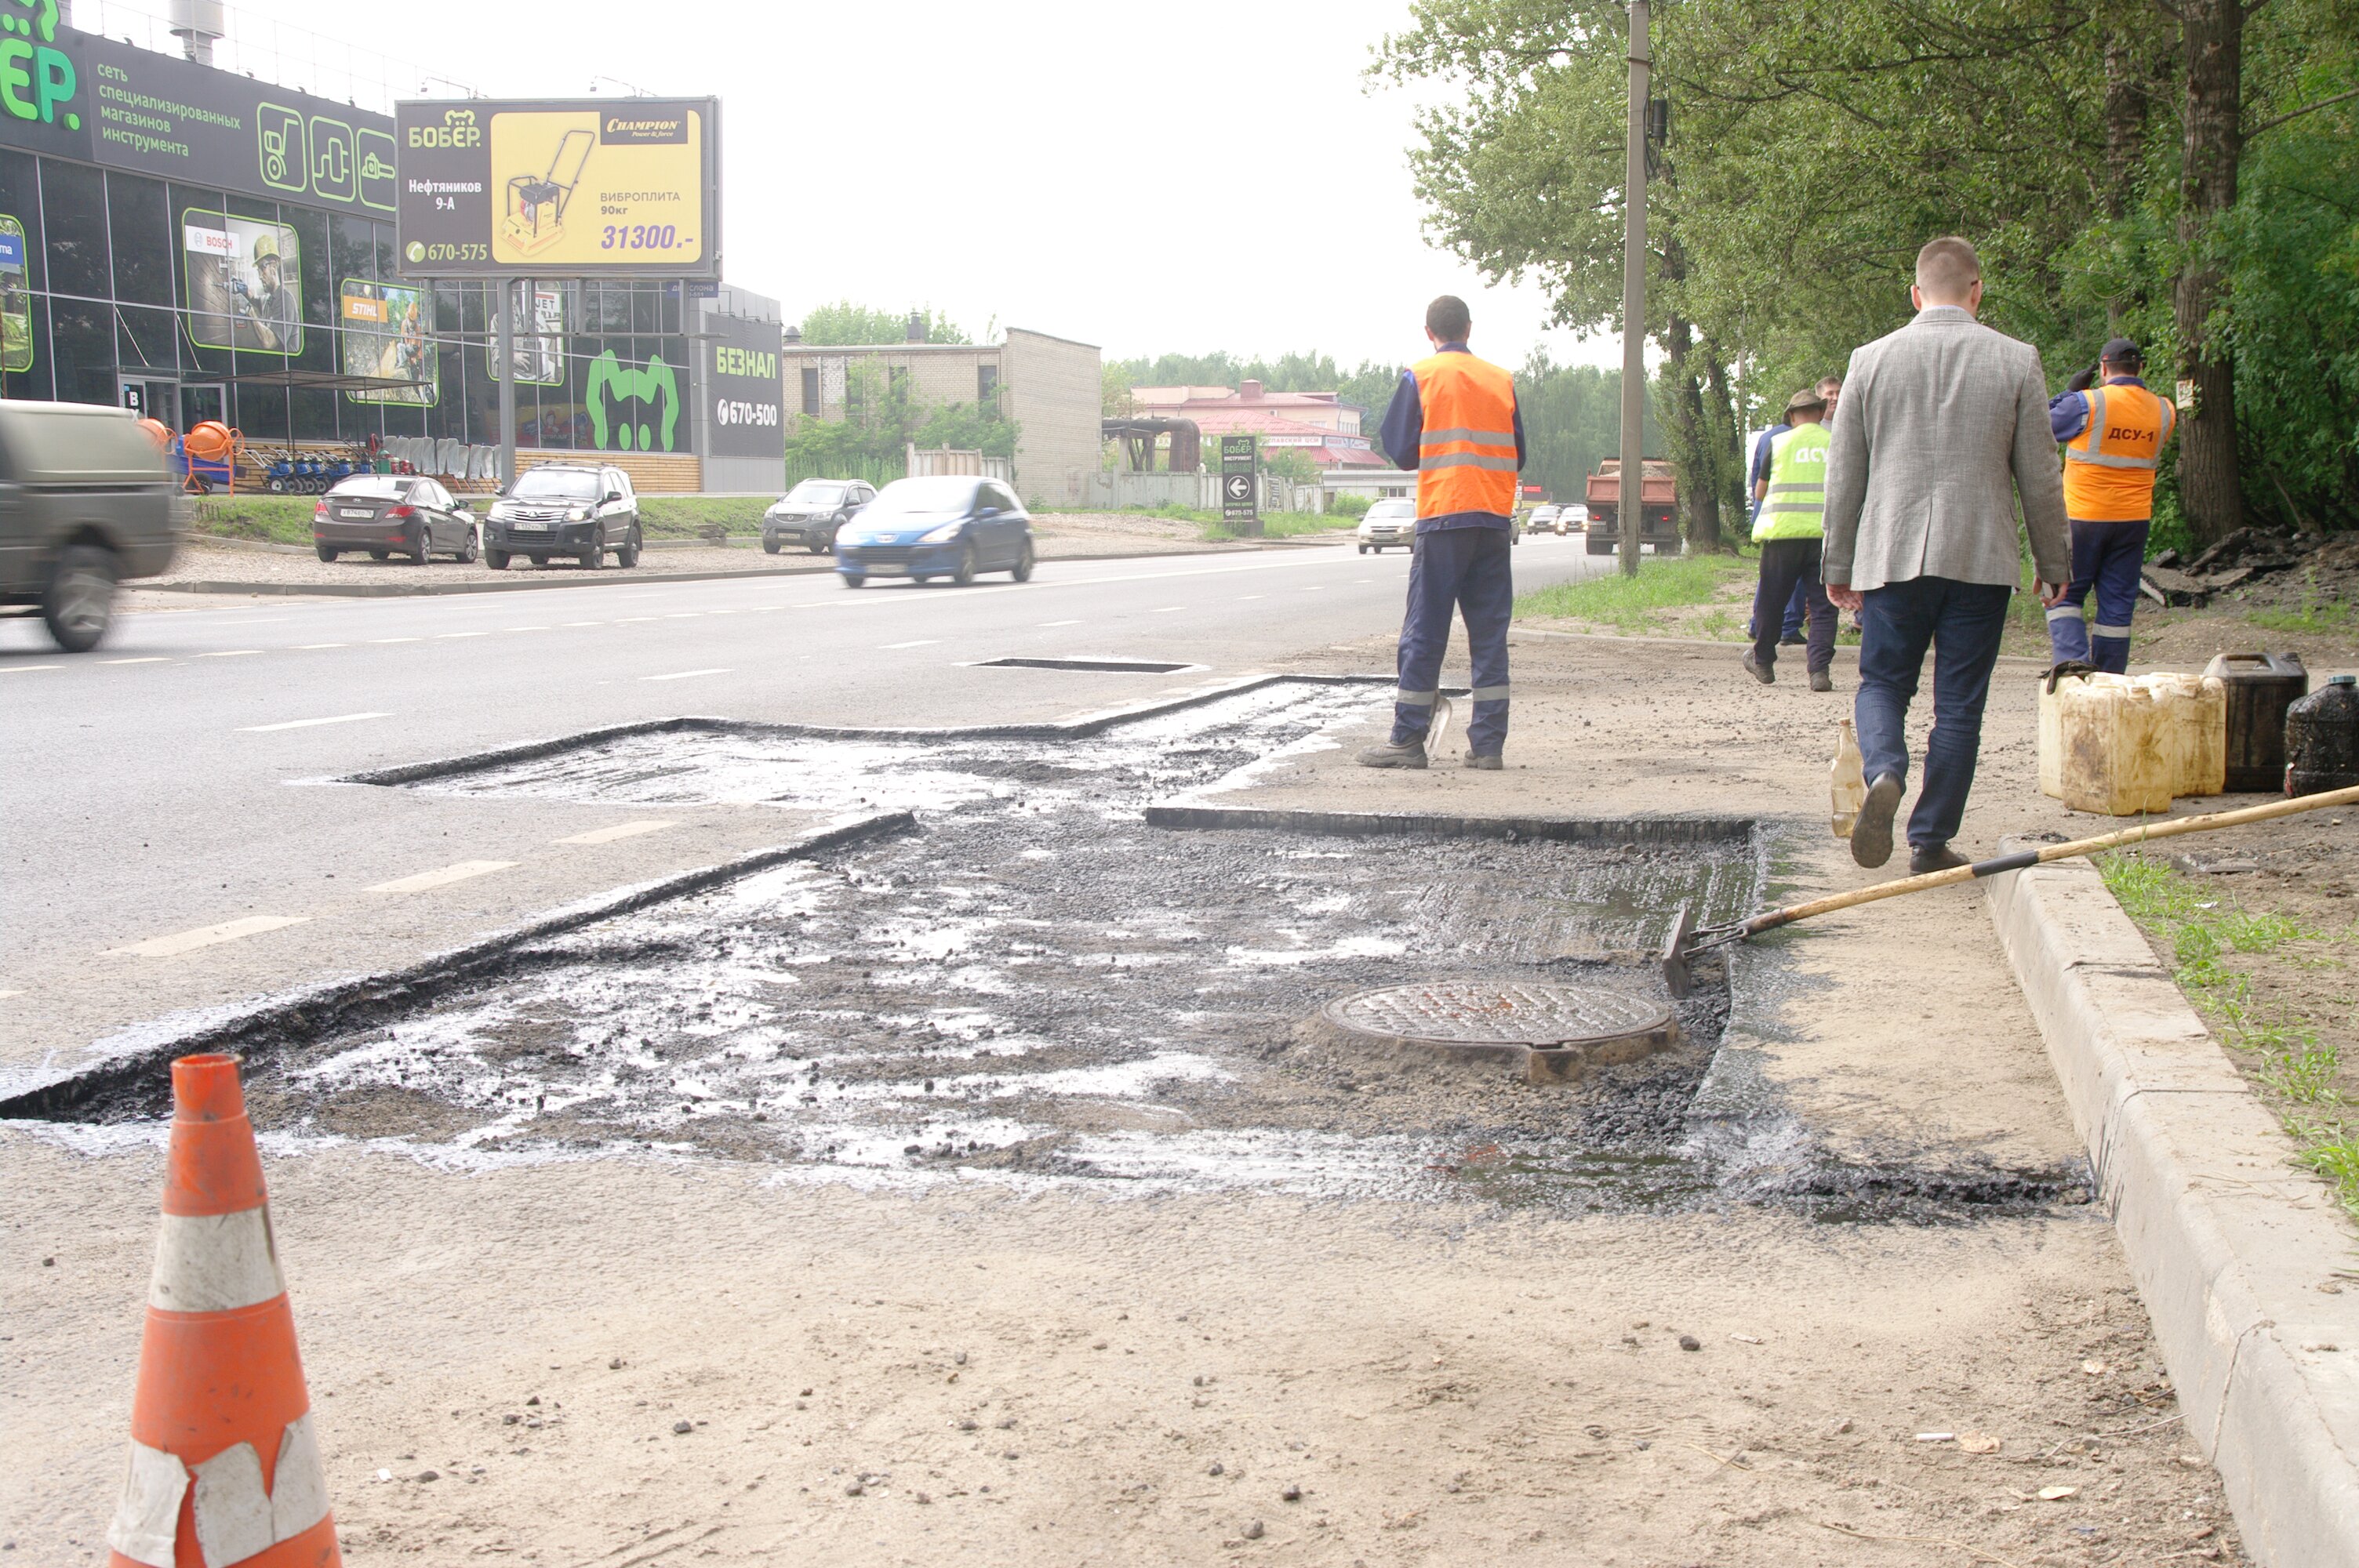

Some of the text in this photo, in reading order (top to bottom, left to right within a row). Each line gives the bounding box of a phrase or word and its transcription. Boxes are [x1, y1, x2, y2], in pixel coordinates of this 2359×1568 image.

[97, 63, 129, 82] сеть
[99, 85, 241, 130] специализированных
[100, 105, 171, 132] магазинов
[103, 126, 189, 157] инструмента
[409, 179, 482, 196] Нефтяников
[435, 197, 455, 210] 9-А
[601, 192, 681, 202] ВИБРОПЛИТА
[601, 205, 628, 215] 90кг
[206, 236, 232, 249] BOSCH
[427, 244, 487, 260] 670-575
[352, 303, 377, 317] STIHL
[535, 299, 555, 309] JET
[716, 346, 776, 379] БЕЗНАЛ
[729, 401, 777, 426] 670-500
[2108, 427, 2154, 442] ДСУ-1
